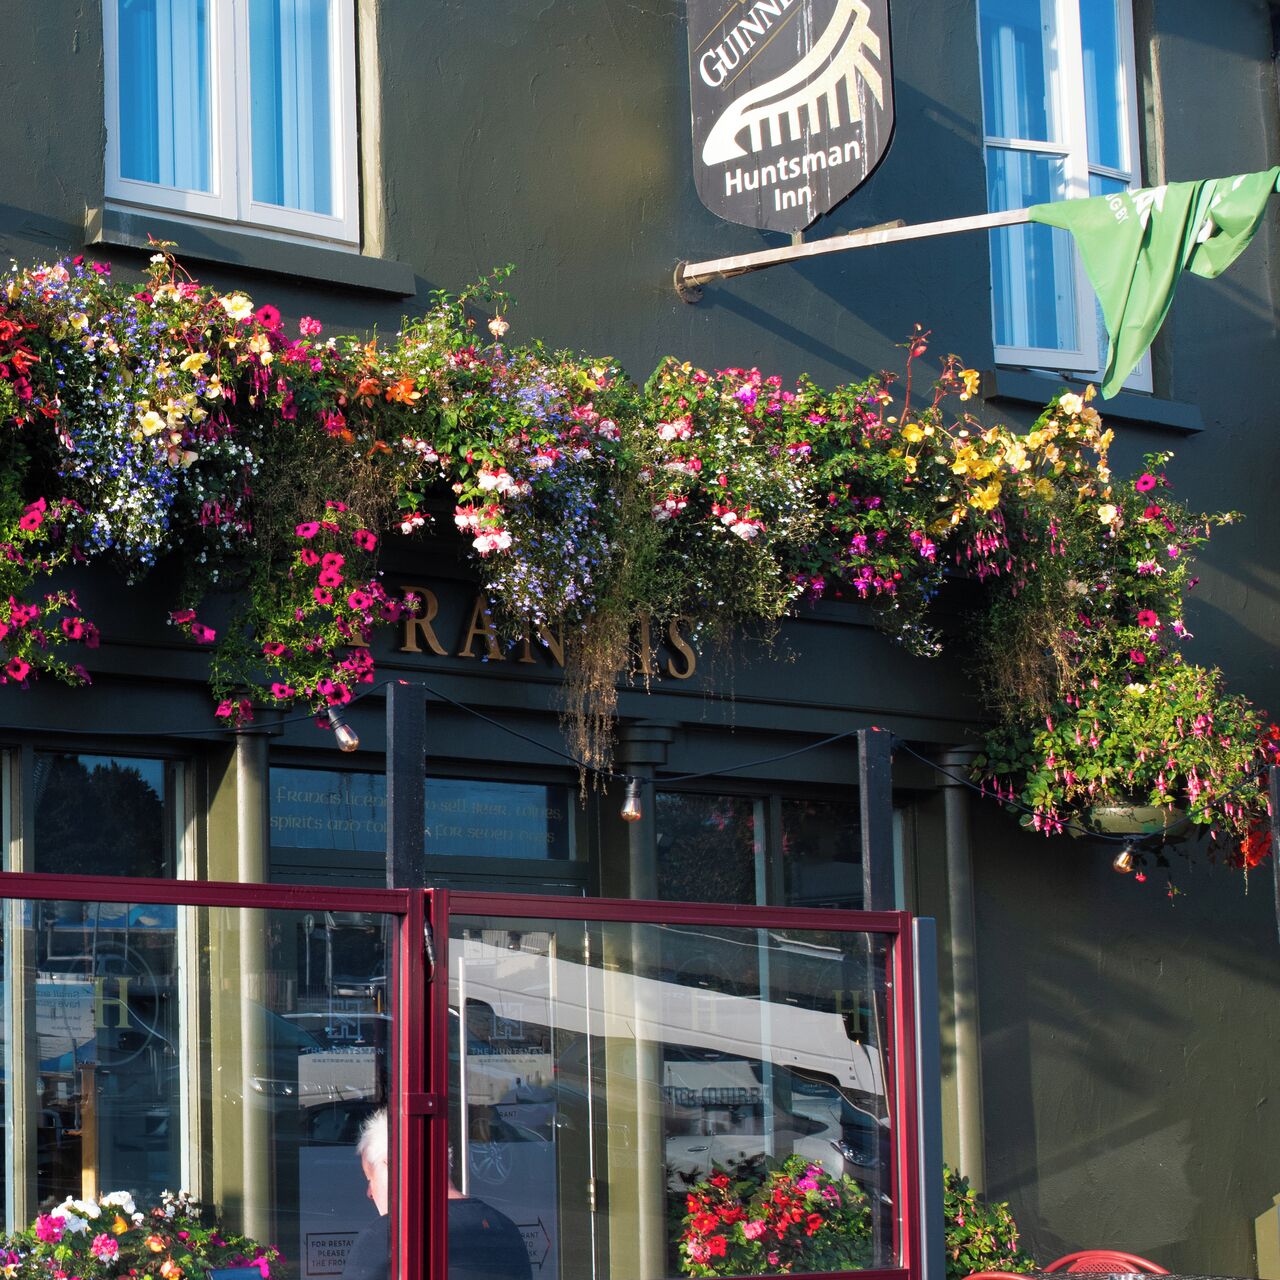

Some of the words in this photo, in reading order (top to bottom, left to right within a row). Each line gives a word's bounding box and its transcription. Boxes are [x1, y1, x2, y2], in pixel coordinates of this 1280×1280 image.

[725, 139, 861, 197] Huntsman
[773, 184, 813, 212] Inn
[1105, 193, 1130, 225] UGBY
[346, 585, 697, 680] RANIS
[269, 814, 323, 832] spirits
[94, 976, 130, 1029] H
[470, 1046, 489, 1056] THE
[311, 1239, 327, 1248] FOR
[317, 1249, 345, 1257] PLEASE
[312, 1259, 326, 1267] THE
